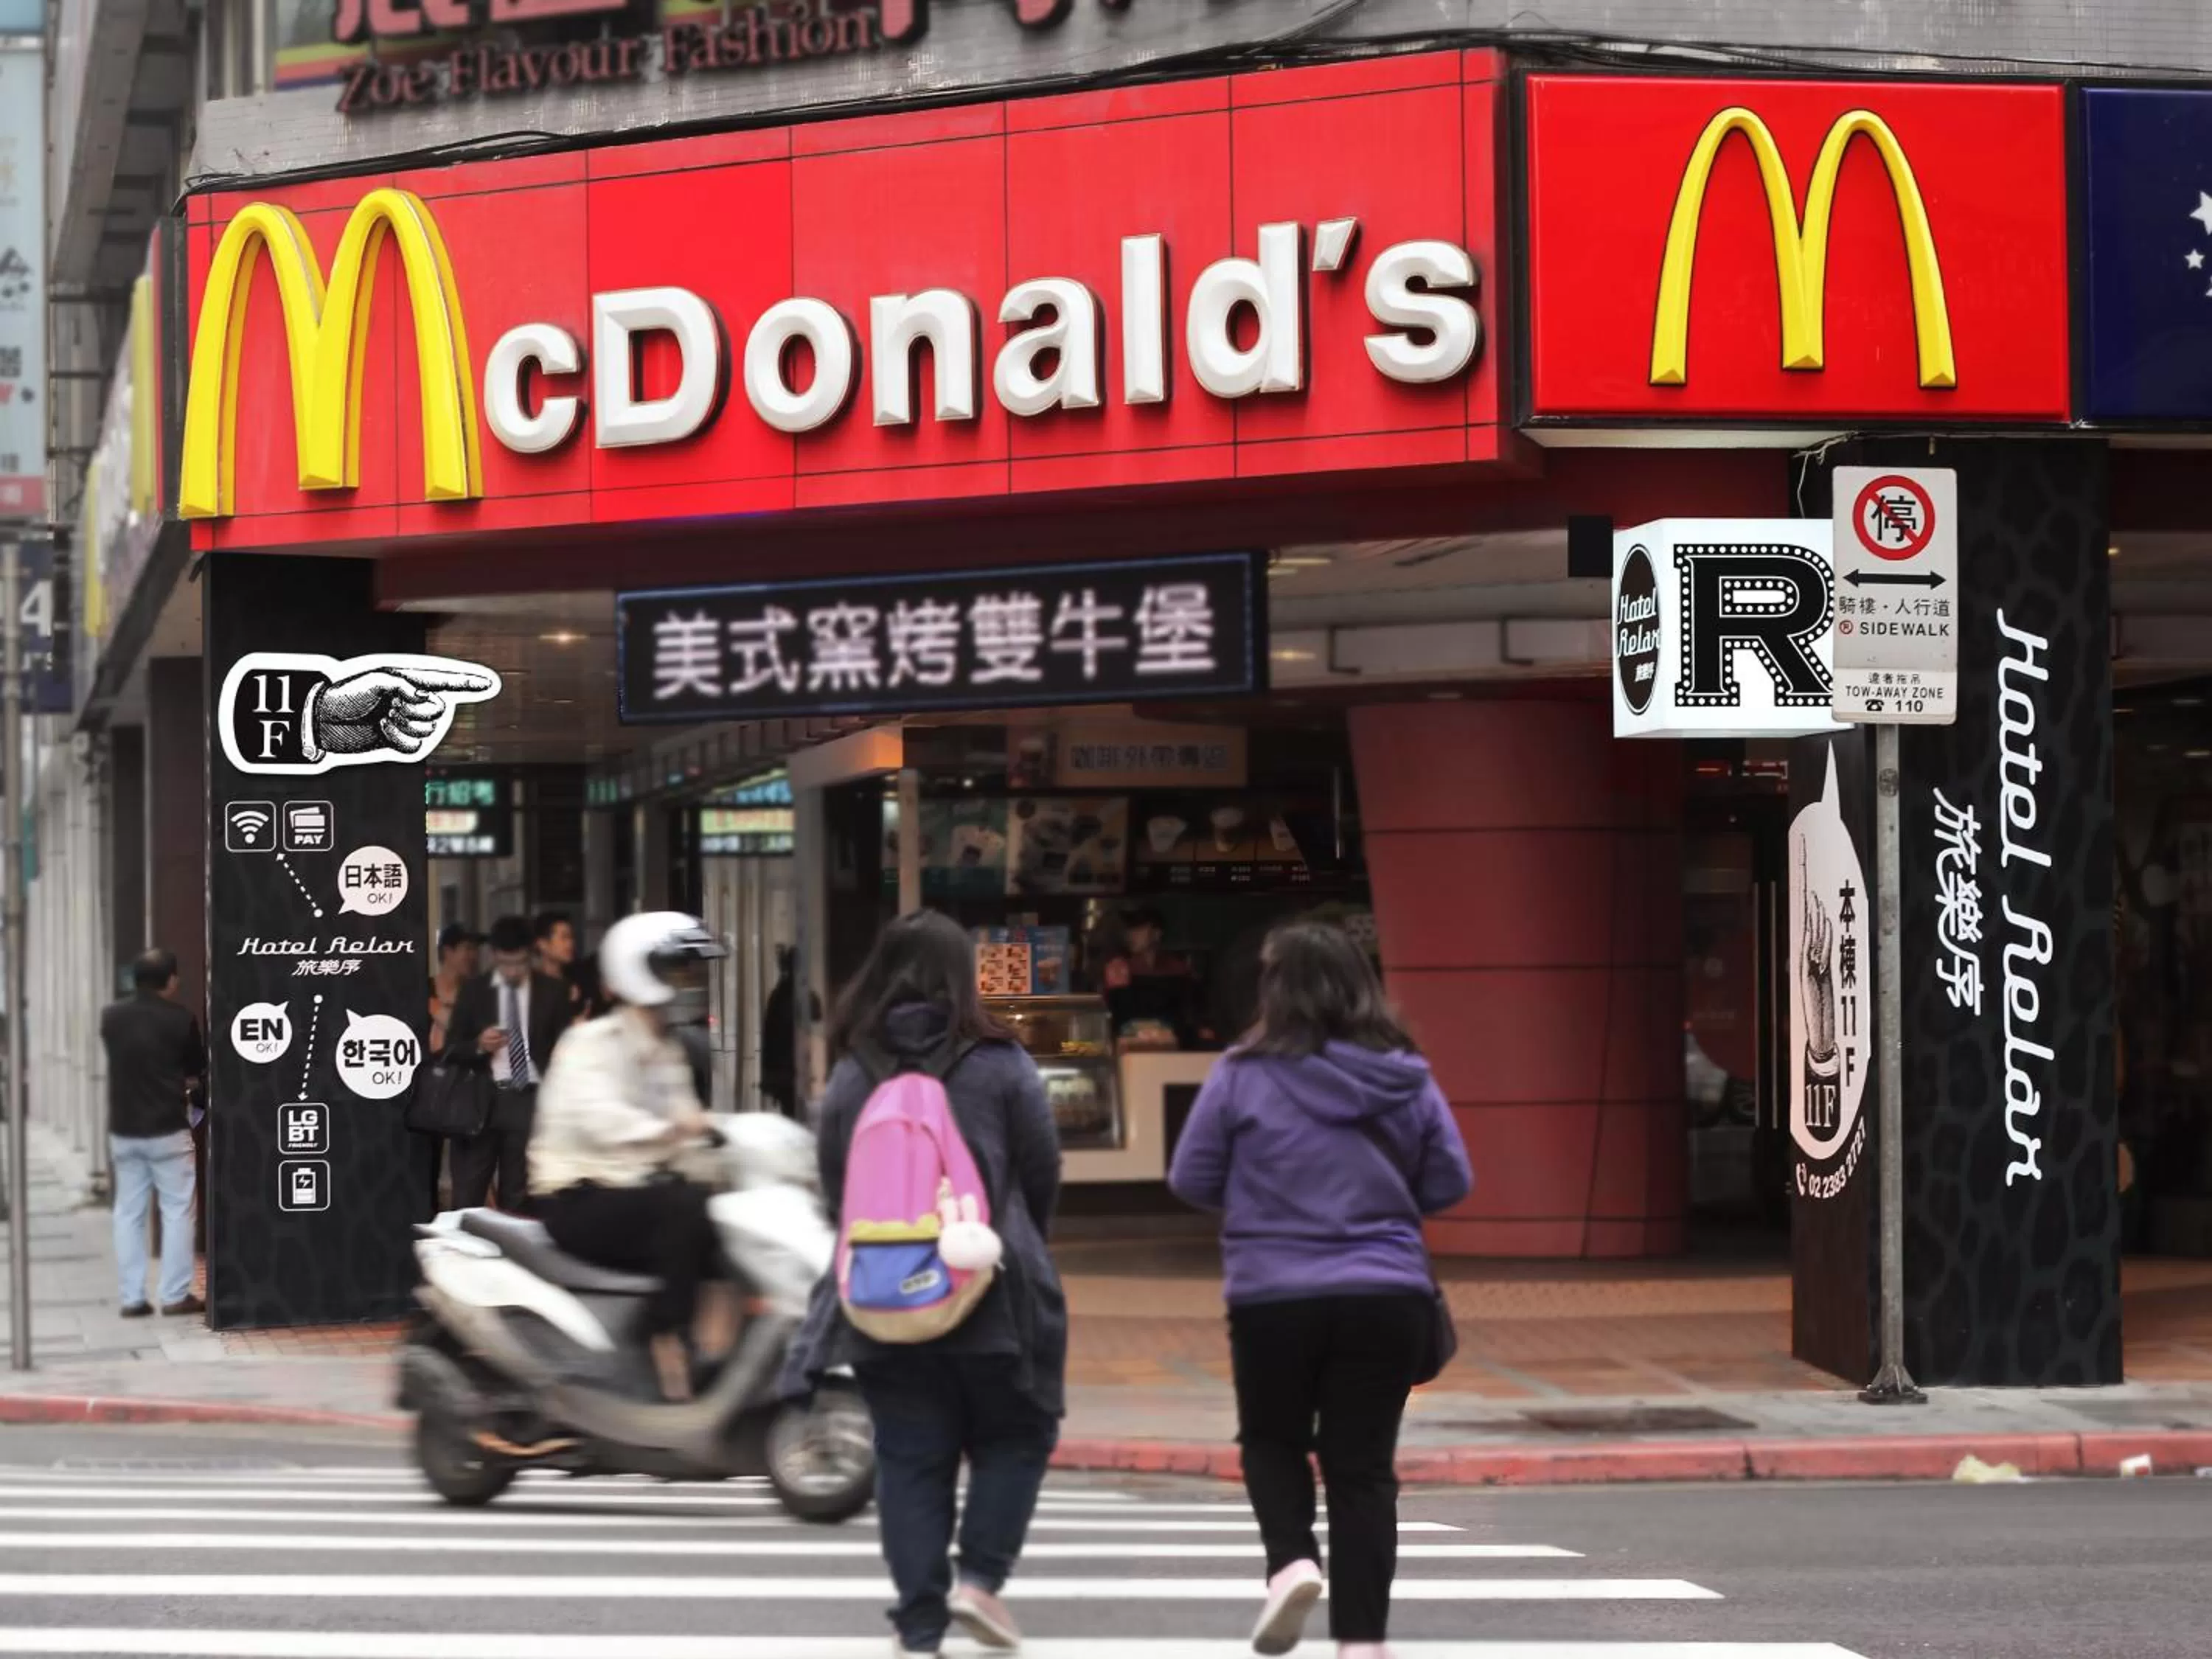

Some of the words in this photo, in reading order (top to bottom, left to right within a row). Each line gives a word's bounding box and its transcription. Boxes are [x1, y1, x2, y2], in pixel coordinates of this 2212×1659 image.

[448, 35, 640, 96] Flavour
[664, 6, 872, 72] Fashion
[1617, 588, 1657, 625] Hotel
[1674, 543, 1834, 708] R
[1860, 622, 1950, 637] SIDEWALK
[652, 582, 1218, 700] 美式窯烤雙牛堡
[1846, 686, 1907, 698] TOW-AWAY
[1912, 687, 1944, 699] ZONE
[1895, 700, 1924, 713] 110
[258, 720, 291, 758] F
[1996, 608, 2052, 868] Hotel
[295, 835, 324, 845] PAY
[344, 863, 403, 888] 日本語
[366, 892, 393, 905] OK!
[1933, 787, 1985, 1016] 旅樂序
[236, 936, 318, 956] Hotel
[240, 1018, 284, 1041] EN
[255, 1043, 279, 1054] OK!
[342, 1038, 417, 1068] 한국어
[372, 1071, 403, 1085] OK!
[1805, 1083, 1837, 1127] 11F
